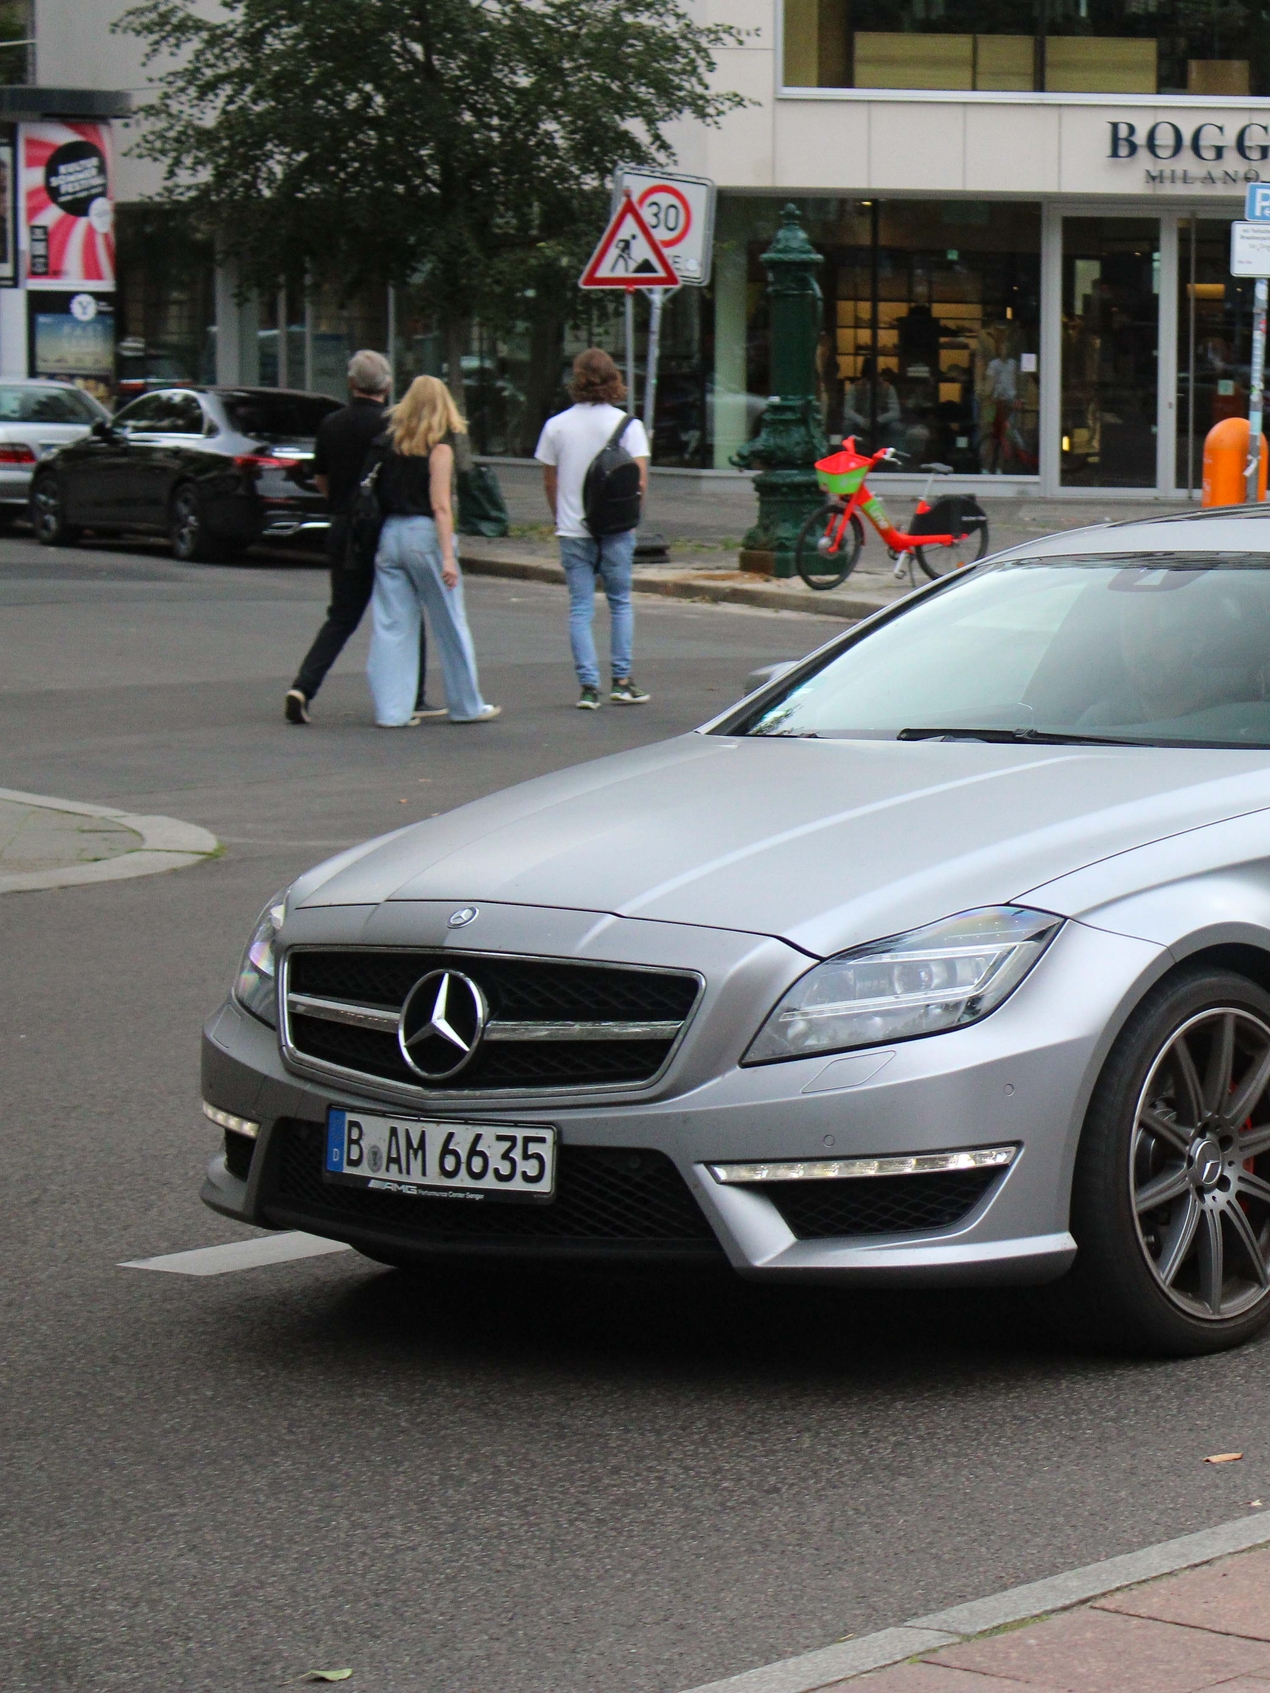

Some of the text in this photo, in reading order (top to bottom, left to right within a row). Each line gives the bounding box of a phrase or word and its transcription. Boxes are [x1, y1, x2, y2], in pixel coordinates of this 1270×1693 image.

[1144, 168, 1260, 184] MILANO
[647, 201, 680, 232] 30
[332, 1148, 340, 1162] D
[346, 1119, 547, 1184] B AM 6635
[383, 1182, 418, 1195] AMG
